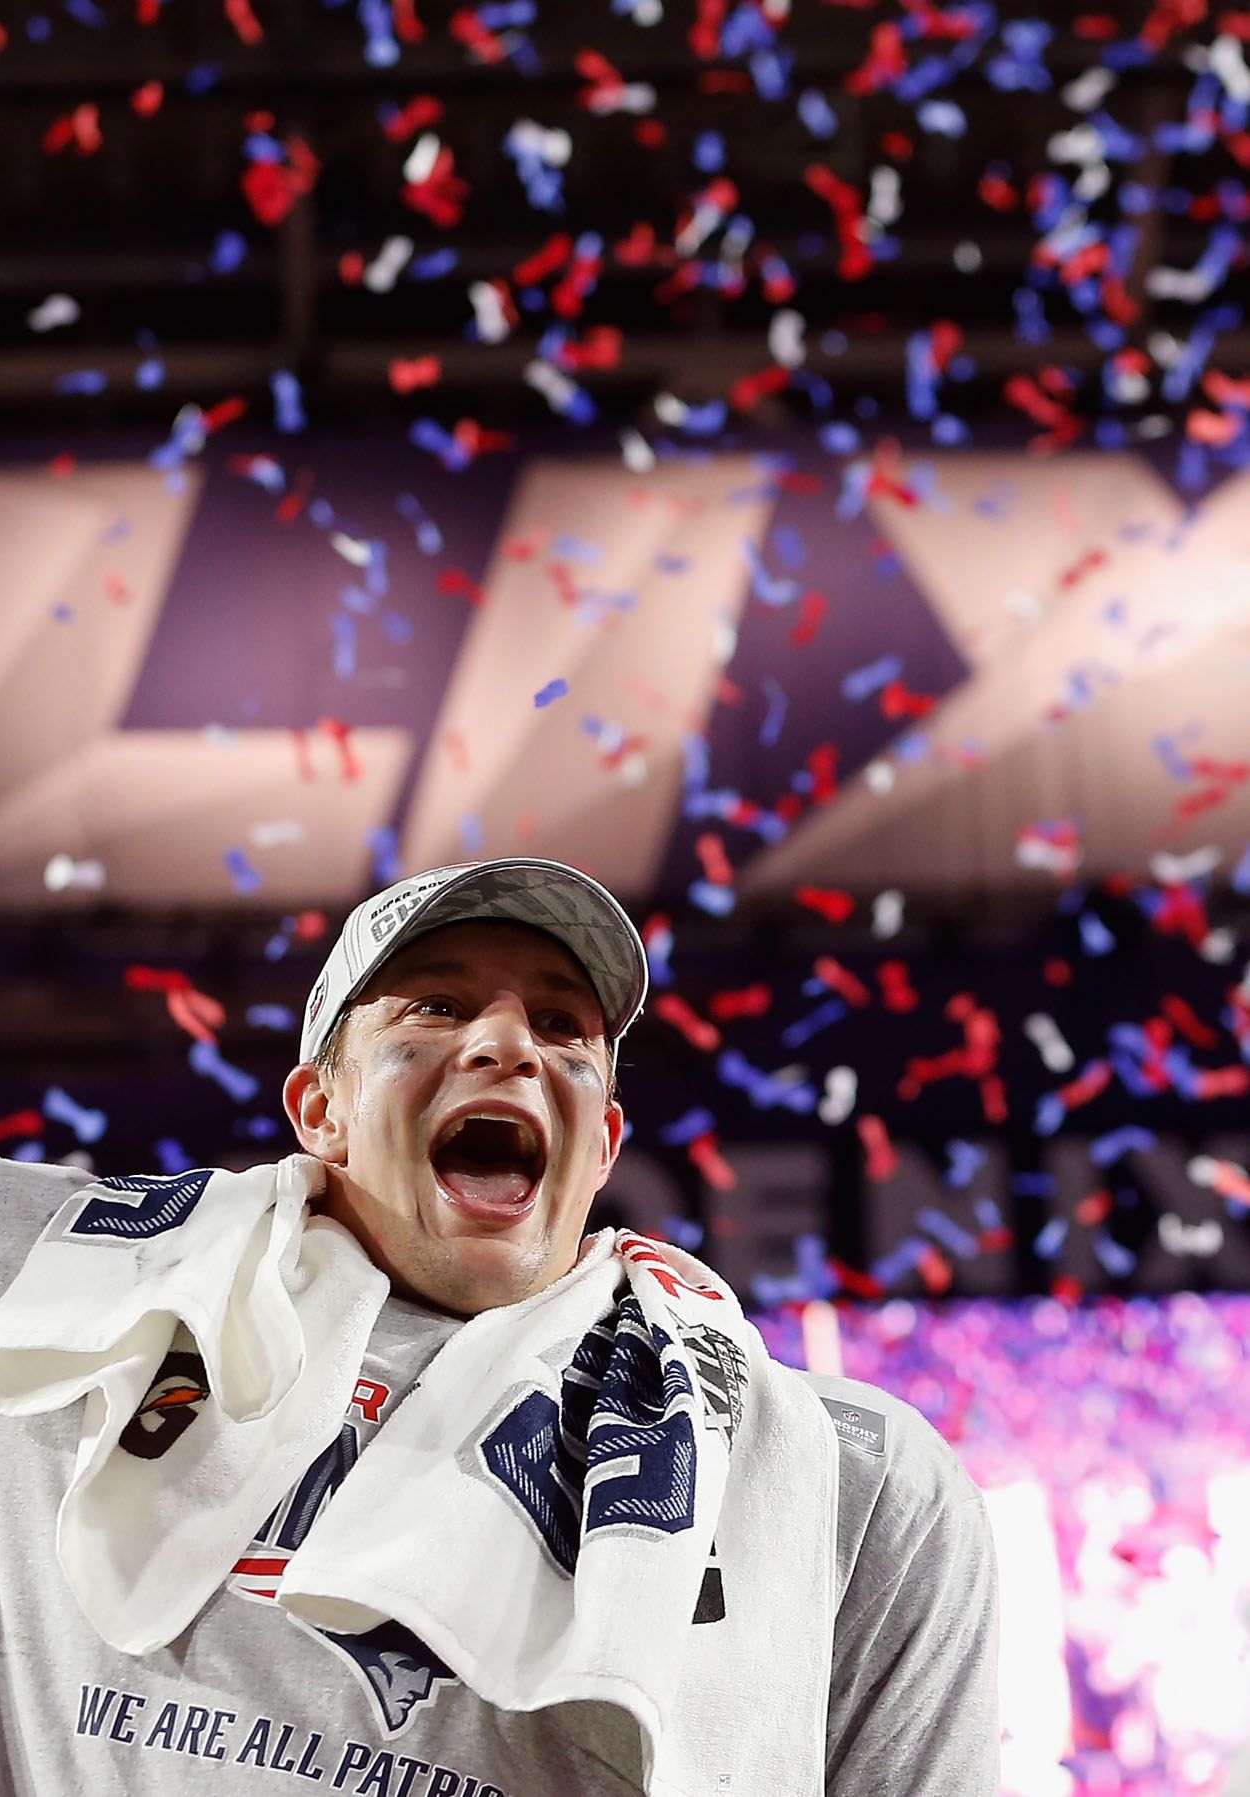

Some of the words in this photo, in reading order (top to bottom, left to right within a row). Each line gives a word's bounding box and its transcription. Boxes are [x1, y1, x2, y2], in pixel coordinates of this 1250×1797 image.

[831, 1417, 880, 1442] ROPHY
[76, 1685, 146, 1744] WE
[144, 1702, 236, 1760] ARE
[236, 1717, 323, 1780] ALL
[332, 1741, 508, 1797] PATR
